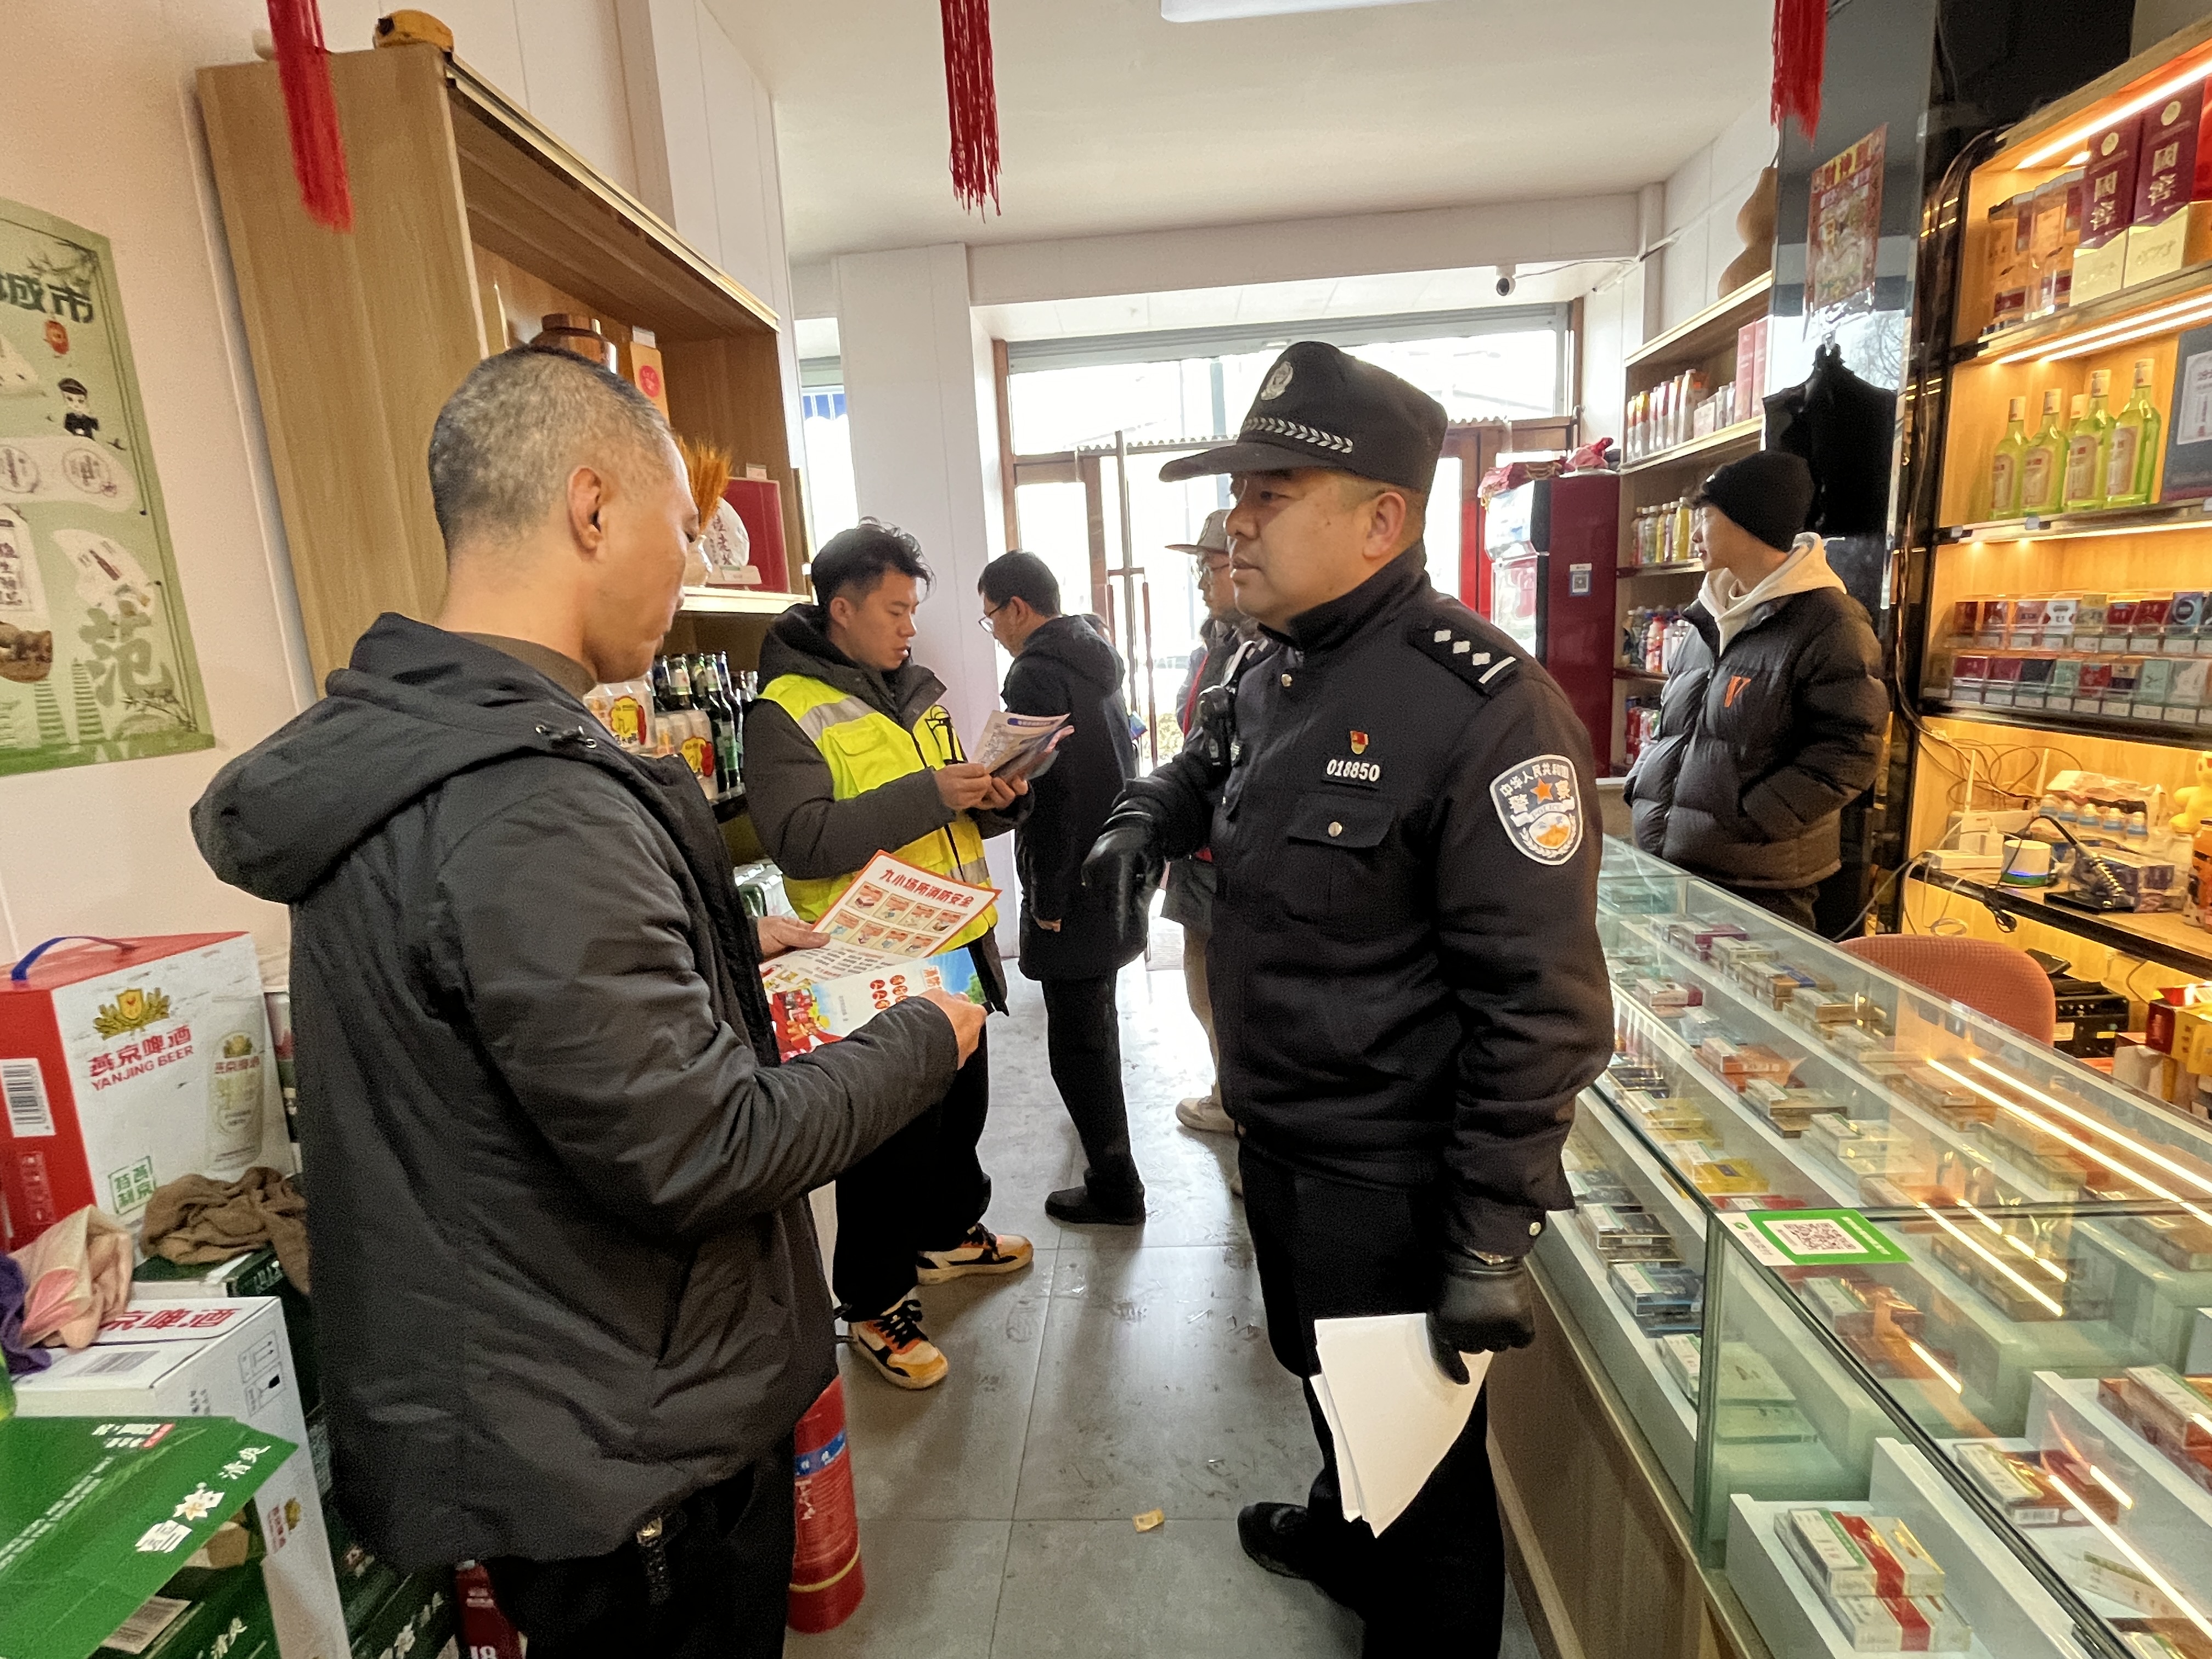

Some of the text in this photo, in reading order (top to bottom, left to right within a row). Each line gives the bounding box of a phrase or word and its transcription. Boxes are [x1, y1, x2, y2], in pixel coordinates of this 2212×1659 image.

[0, 272, 94, 324] 城市
[1326, 758, 1381, 782] 018850
[1499, 762, 1570, 797] 中华人民共和国
[879, 868, 975, 909] 九小场所消防安全
[88, 1024, 192, 1077] 燕京啤酒
[91, 1045, 194, 1091] YANJING BEER
